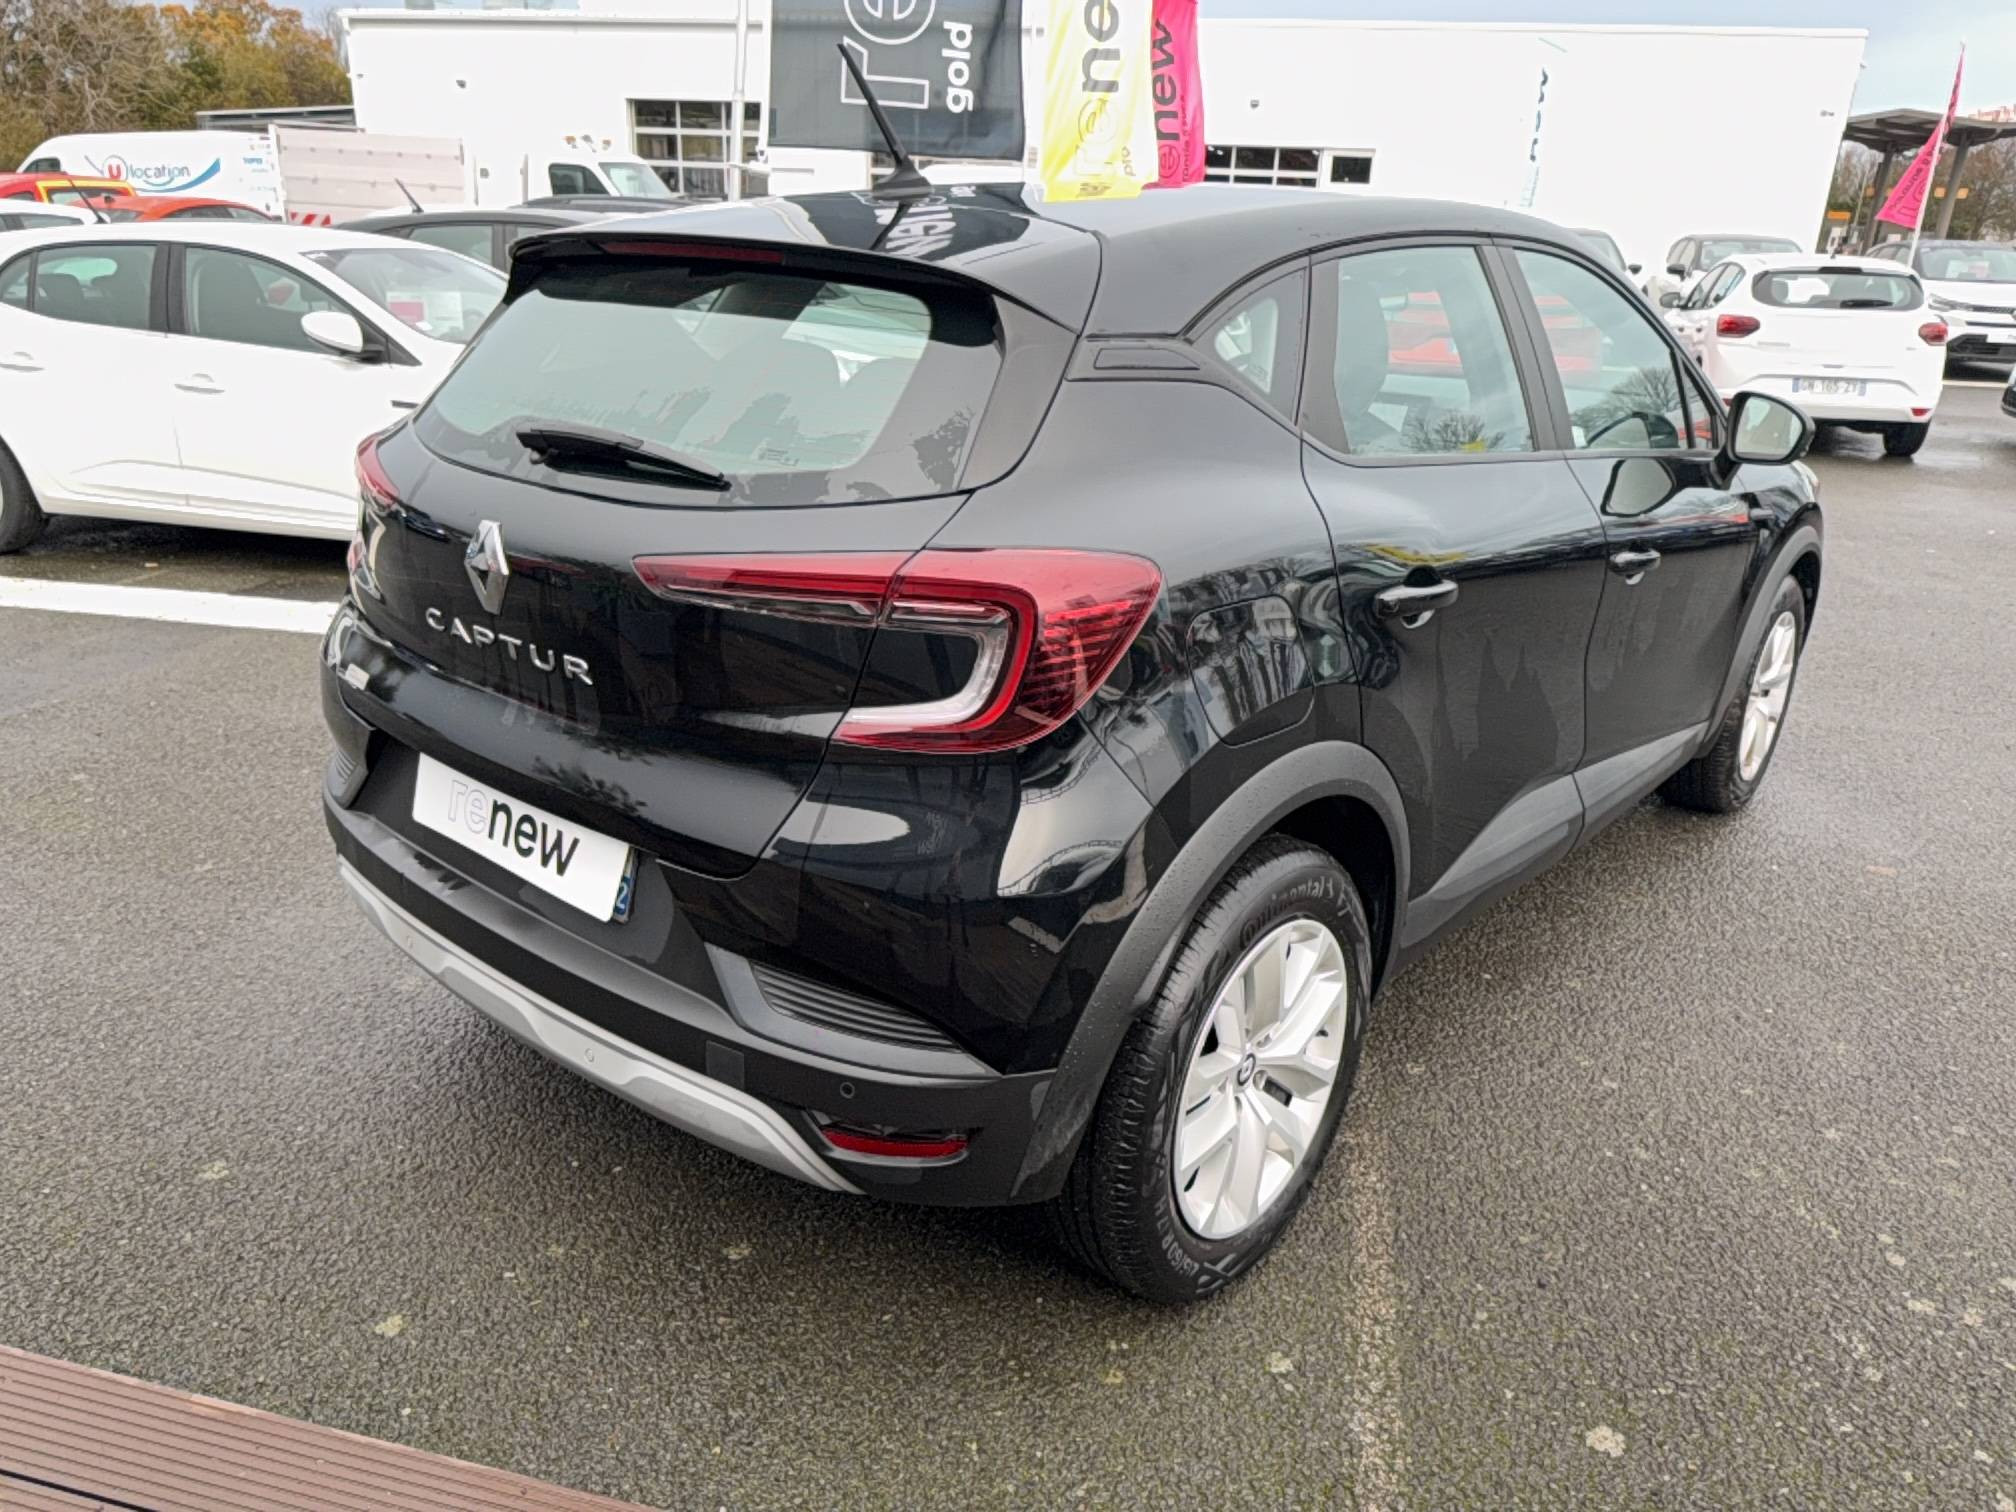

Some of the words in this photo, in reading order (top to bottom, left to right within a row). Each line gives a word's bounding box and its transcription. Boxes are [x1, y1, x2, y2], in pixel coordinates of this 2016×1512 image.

[942, 22, 973, 113] gold
[129, 164, 190, 179] location
[425, 607, 593, 686] CAPTUR
[447, 779, 580, 877] renew
